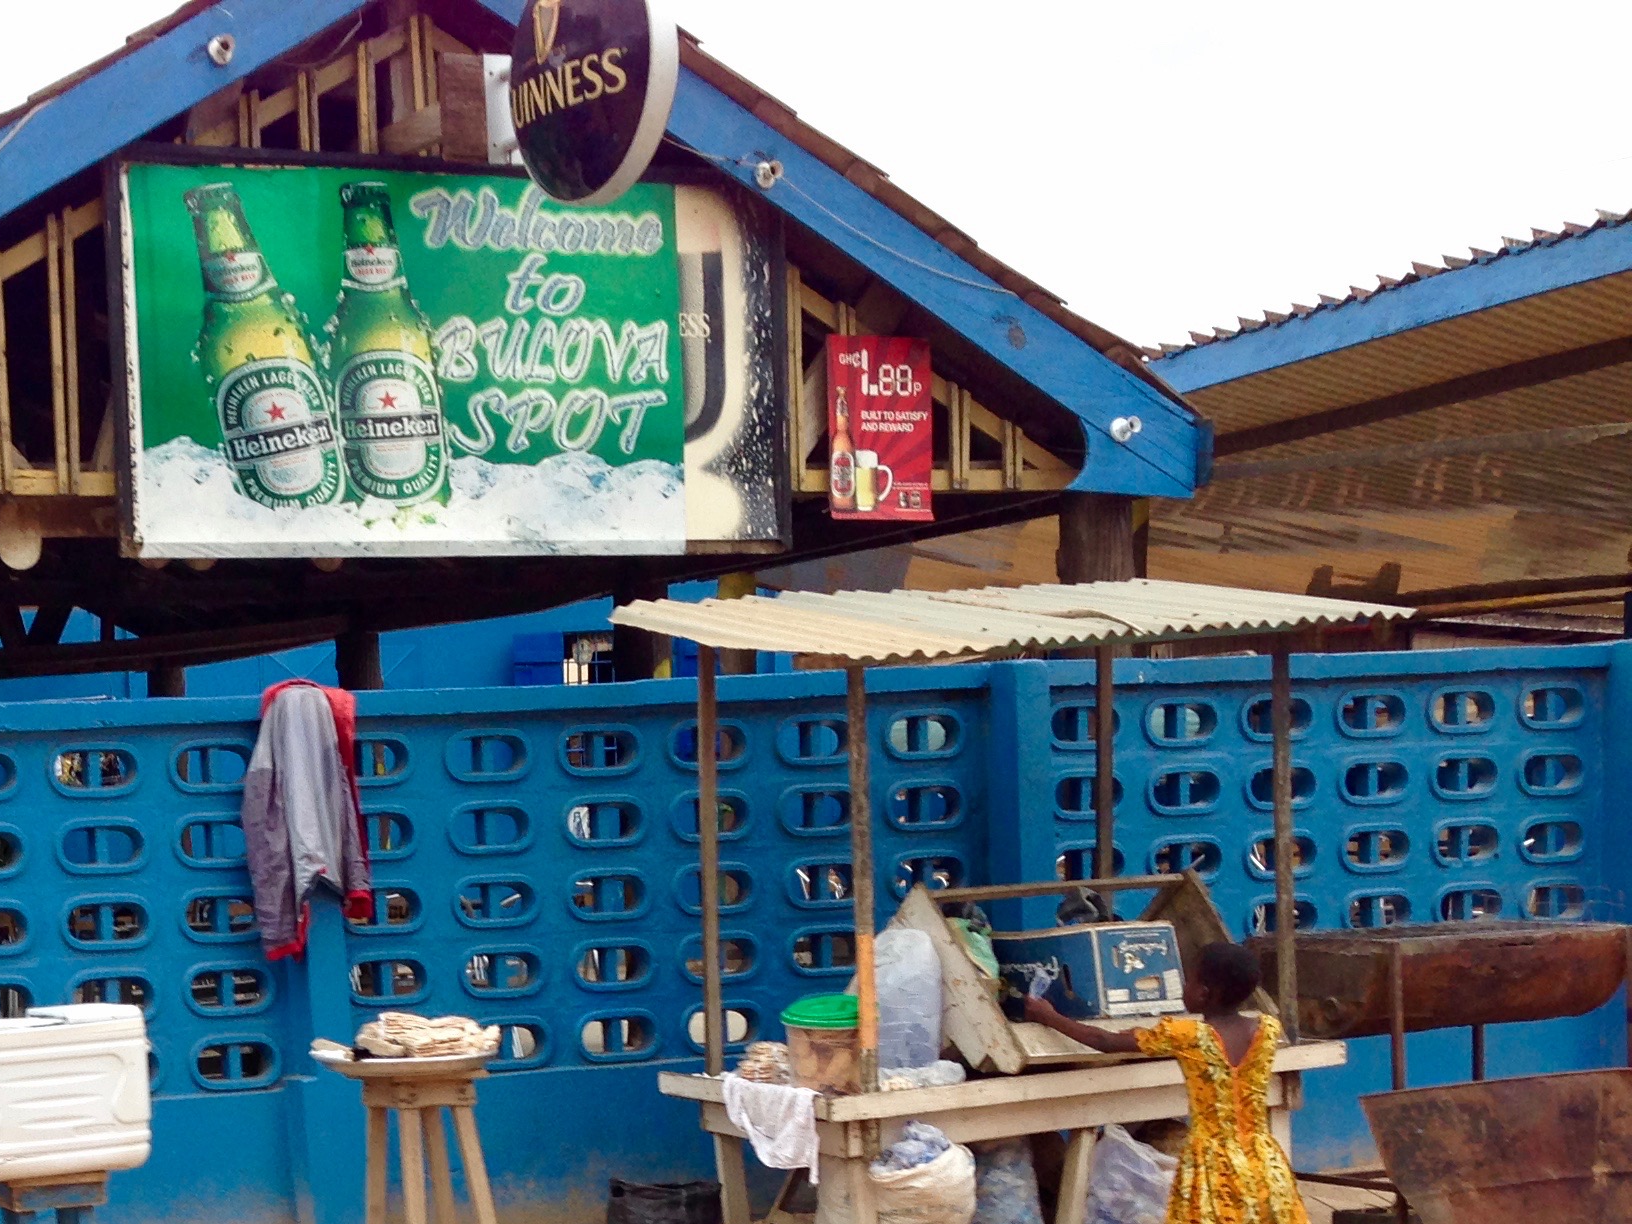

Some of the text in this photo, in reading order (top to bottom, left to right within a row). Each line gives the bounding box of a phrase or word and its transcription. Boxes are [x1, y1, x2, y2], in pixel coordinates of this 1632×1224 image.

[511, 47, 627, 128] UINNESS
[410, 184, 663, 255] Welcome
[505, 253, 586, 315] to
[435, 316, 669, 383] BULOVA
[233, 421, 332, 460] Heineken
[344, 417, 438, 438] Heineken
[447, 387, 667, 454] SPOT
[860, 421, 879, 432] AND
[883, 410, 895, 420] TO
[352, 455, 439, 495] PREMIUM QUALITY
